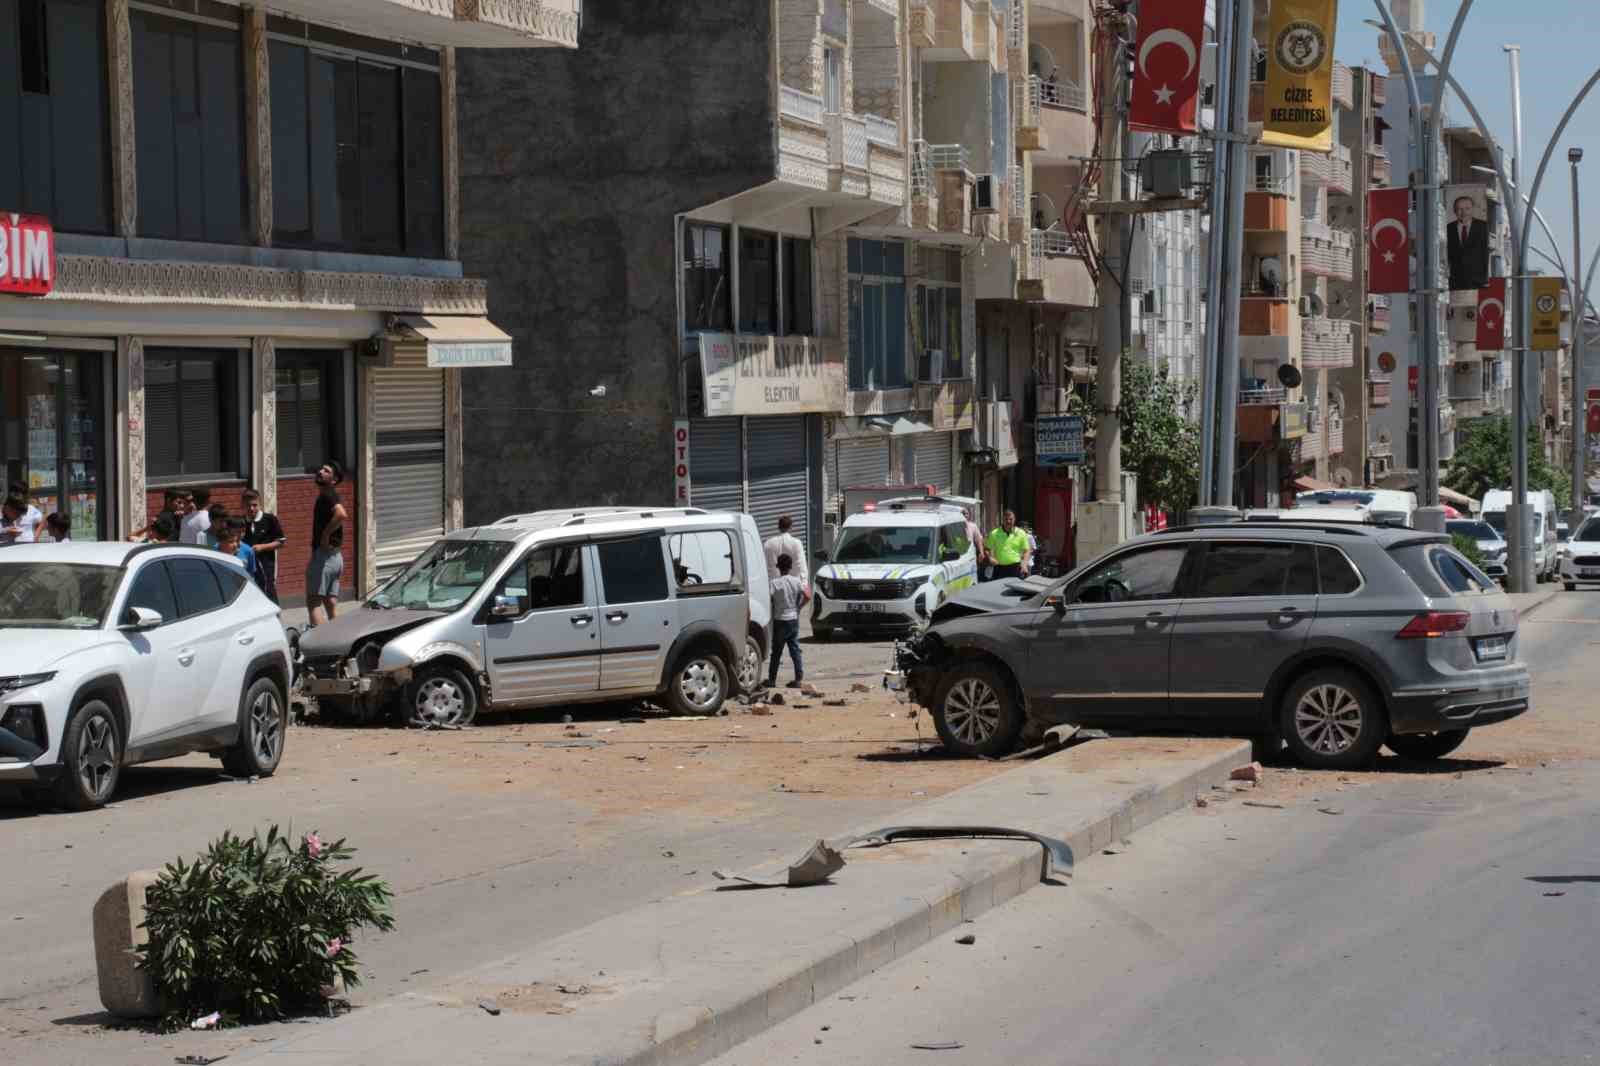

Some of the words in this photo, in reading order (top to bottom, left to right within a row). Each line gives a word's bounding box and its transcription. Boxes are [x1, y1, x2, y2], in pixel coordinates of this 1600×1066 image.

[1284, 84, 1313, 103] CİZRE
[1270, 105, 1326, 122] BELEDİYESİ
[764, 384, 799, 403] ELEKTRİK
